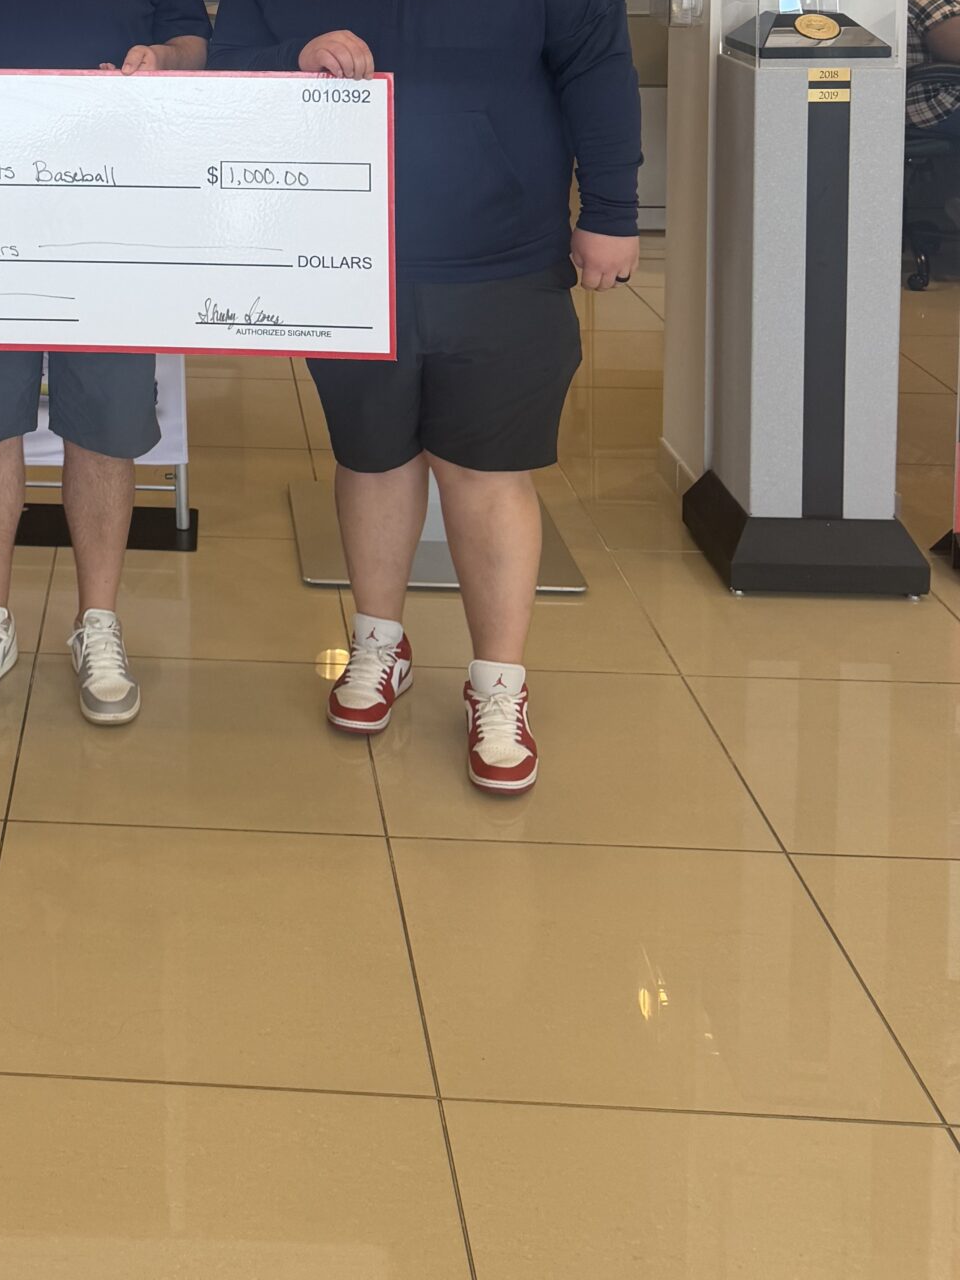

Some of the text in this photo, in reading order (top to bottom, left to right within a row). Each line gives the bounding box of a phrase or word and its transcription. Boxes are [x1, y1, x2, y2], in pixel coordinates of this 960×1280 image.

[820, 70, 839, 79] 2018
[301, 89, 371, 104] 0010392
[819, 91, 839, 100] 2019
[33, 161, 117, 186] Baseball
[207, 166, 218, 186] $
[230, 167, 309, 186] 1,000.00
[298, 255, 372, 269] DOLLARS
[236, 328, 332, 338] AUTHORIZED SIGNATURE
